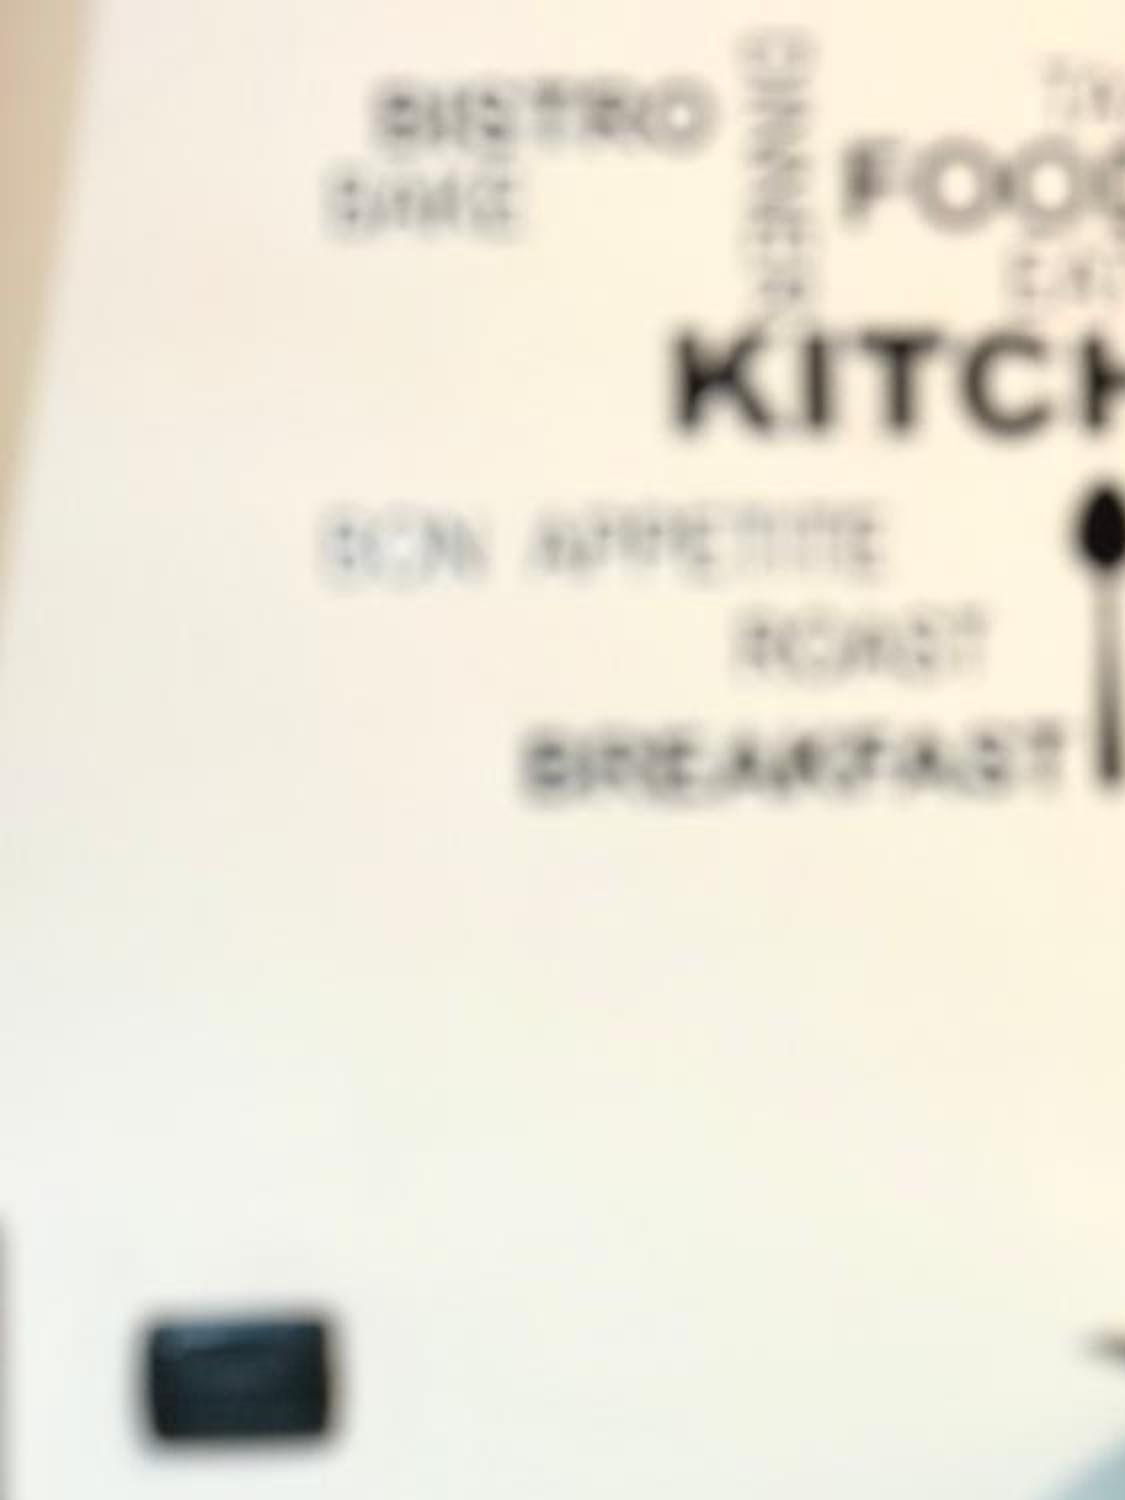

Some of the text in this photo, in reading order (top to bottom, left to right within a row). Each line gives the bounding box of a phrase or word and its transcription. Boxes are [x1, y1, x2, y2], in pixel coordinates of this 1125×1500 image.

[374, 79, 713, 149] BISTRO
[532, 503, 884, 580] APPETITE
[738, 604, 986, 680] ROAST
[523, 722, 1066, 804] BREAKFAST
